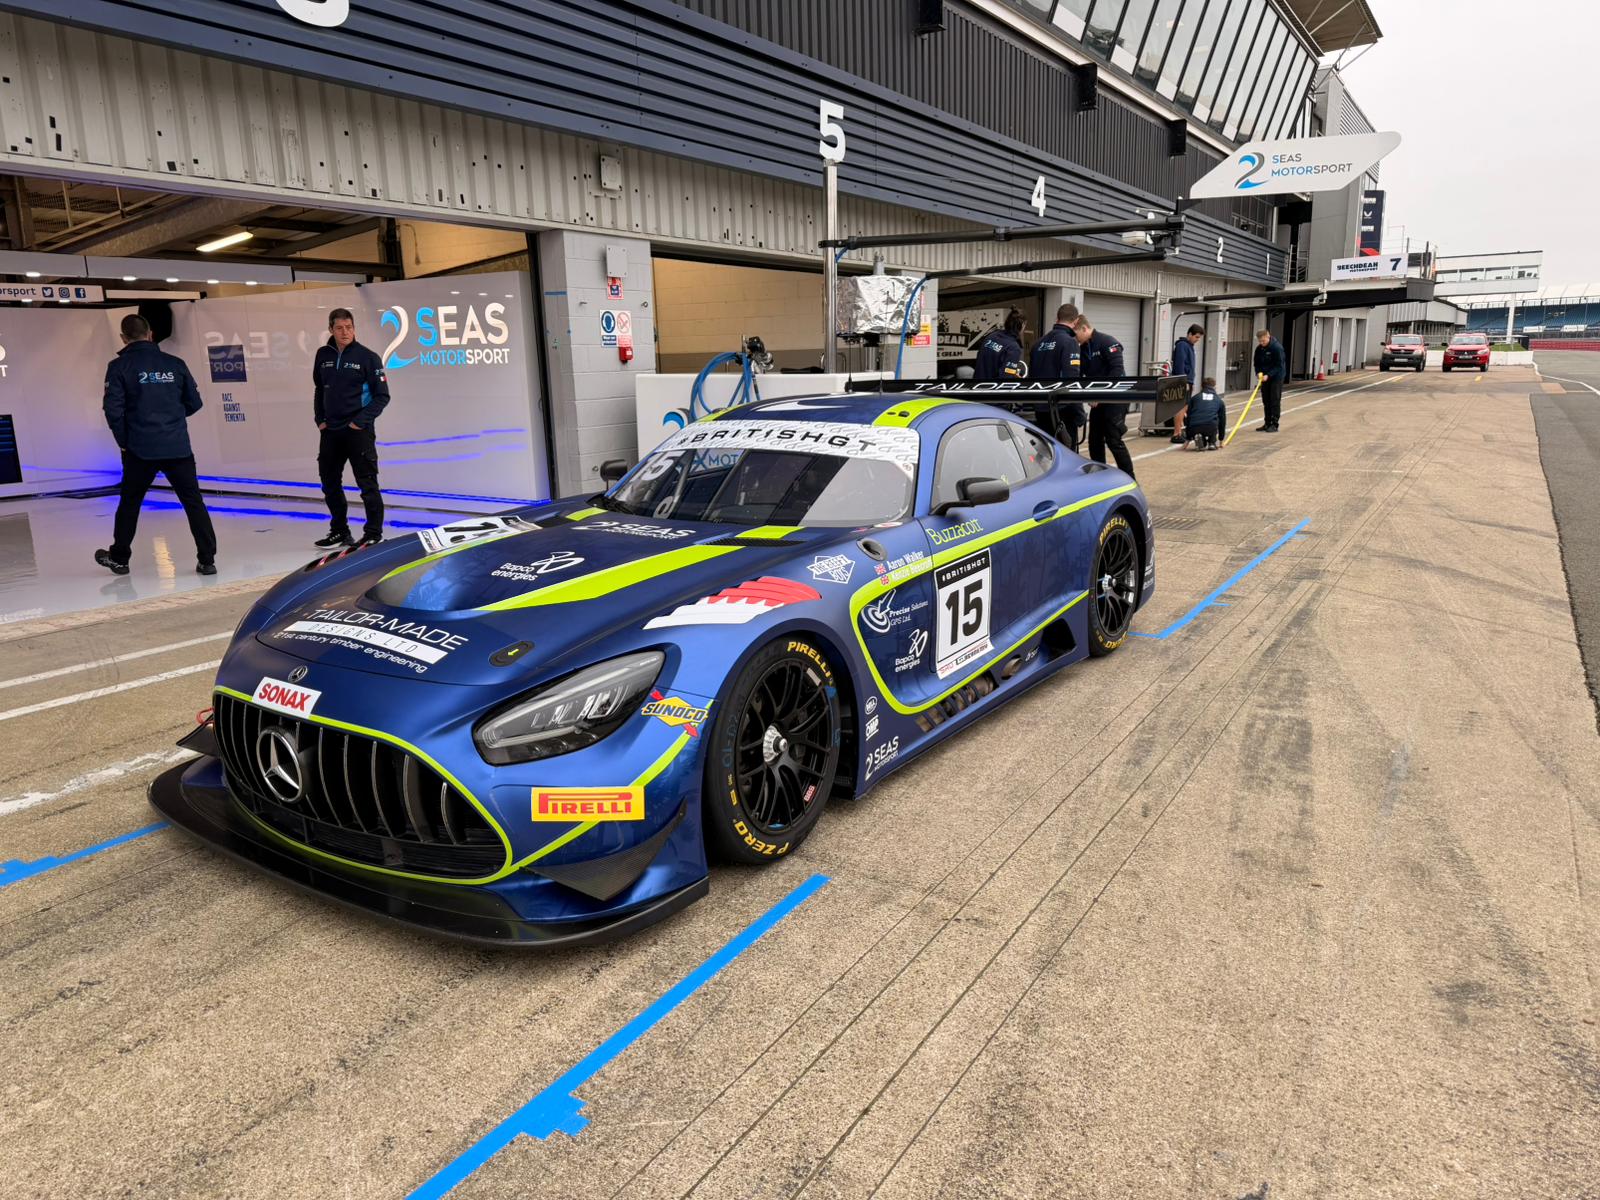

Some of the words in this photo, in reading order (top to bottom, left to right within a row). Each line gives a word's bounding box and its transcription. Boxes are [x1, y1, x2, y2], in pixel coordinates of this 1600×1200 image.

[819, 99, 846, 162] 5
[1272, 153, 1302, 164] SEAS
[1271, 163, 1353, 177] MOTORSPORT
[1031, 175, 1046, 217] 4
[1216, 237, 1224, 264] 2
[1266, 252, 1270, 275] 1
[1336, 262, 1379, 271] BEECHDEAN
[1390, 258, 1401, 271] 7
[416, 302, 509, 347] SEAS
[419, 348, 510, 366] MOTORSPORT
[149, 372, 175, 380] SEAS
[913, 380, 1138, 392] TAILOR-MADE
[613, 523, 697, 537] SEAS
[925, 518, 984, 545] Buzzacott
[501, 562, 536, 574] Bapco
[887, 558, 906, 571] Aaron
[903, 551, 924, 564] Walker
[491, 569, 539, 582] energies
[889, 607, 910, 617] Precise
[945, 579, 983, 646] 15
[307, 609, 469, 650] TAILOR-MADE
[307, 623, 377, 641] DESIGNS
[383, 638, 418, 653] LTD
[294, 633, 331, 643] century
[330, 637, 364, 650] timber
[363, 647, 428, 674] engineering
[787, 641, 831, 678] PIRELLI
[895, 655, 914, 666] Bapco
[895, 659, 920, 673] energies
[258, 683, 312, 711] SONAX
[643, 703, 707, 723] SUNOCO
[874, 736, 899, 764] SEAS
[538, 792, 633, 814] PIRELLI
[734, 820, 777, 855] ZERO
